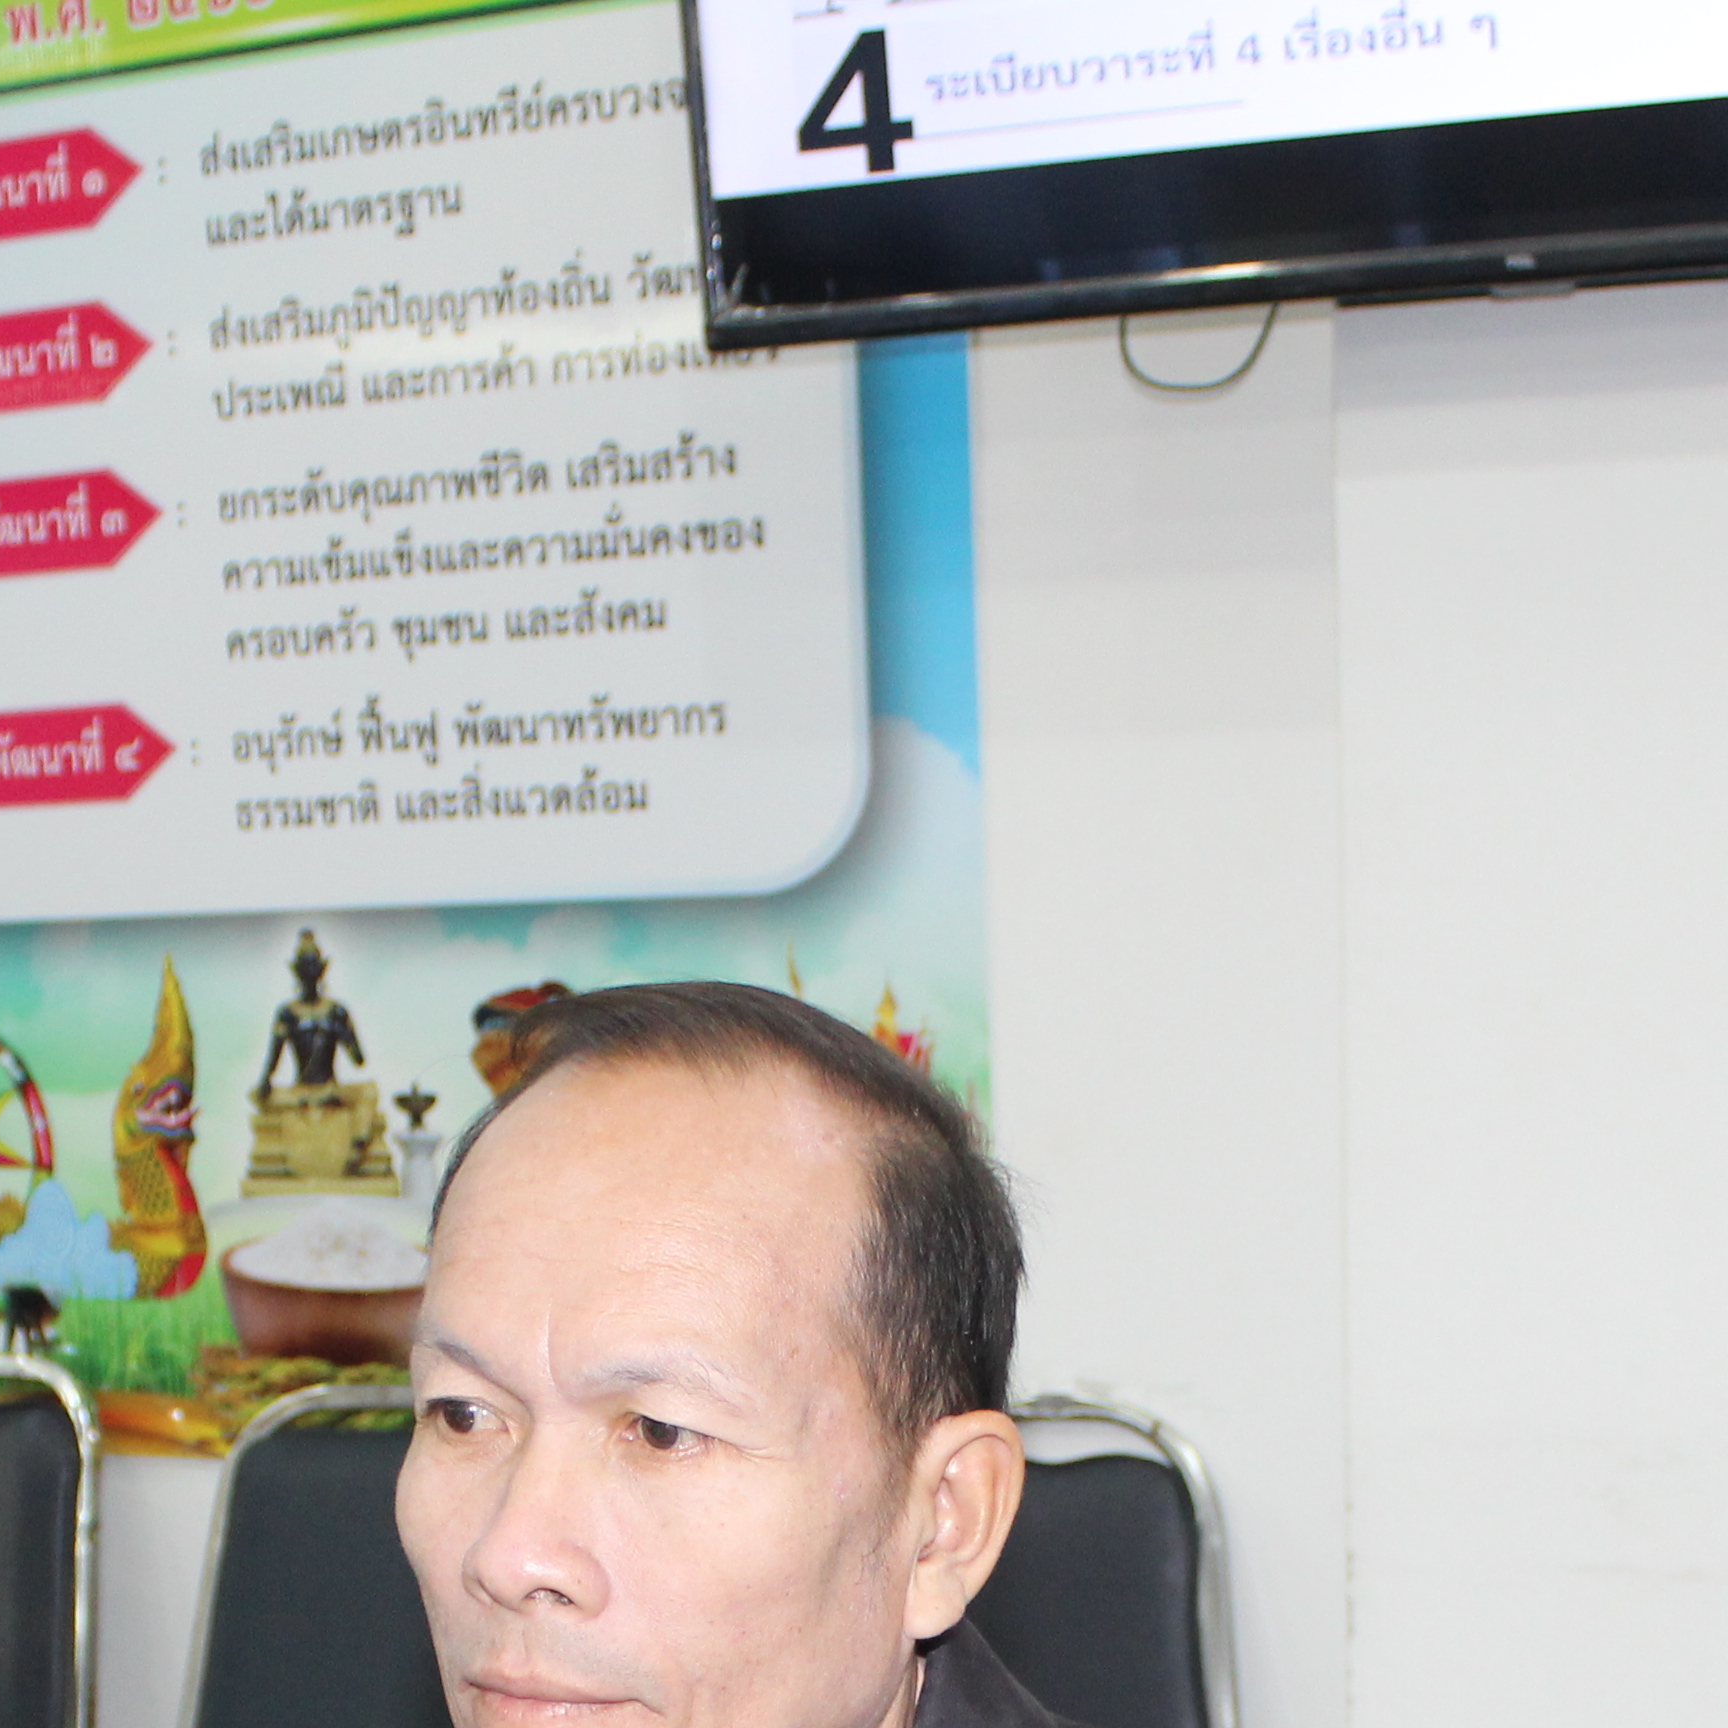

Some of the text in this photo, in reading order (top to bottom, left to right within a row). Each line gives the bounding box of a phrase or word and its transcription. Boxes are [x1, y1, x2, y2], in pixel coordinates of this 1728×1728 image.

[796, 8, 1498, 172] 4 ระเบียบวาระที่ 4 เรื่องอื่น ๆ
[206, 179, 462, 247] และได้มาตรฐาน
[207, 249, 611, 351] ส่งเสริมภูมิปัญญาท้องถิ่น
[89, 333, 117, 367] ๒
[213, 358, 347, 421] ประเพณี
[362, 345, 536, 405] และการค้า
[220, 450, 549, 523] ยกระดับคุณภาพชีวิต
[567, 432, 736, 493] เสริมสร้าง
[223, 503, 764, 592] ความเข้มแข็งและความมั่นคงของ
[227, 587, 667, 662] ครอบครัว ชุมชน และสังคม
[232, 709, 343, 773] อนุรักษ์
[359, 695, 438, 765] ฟื้นฟู
[455, 695, 727, 749] พัฒนาทรัพยากร
[236, 761, 649, 832] ธรรมชาติ และสิ่งแวดล้อม
